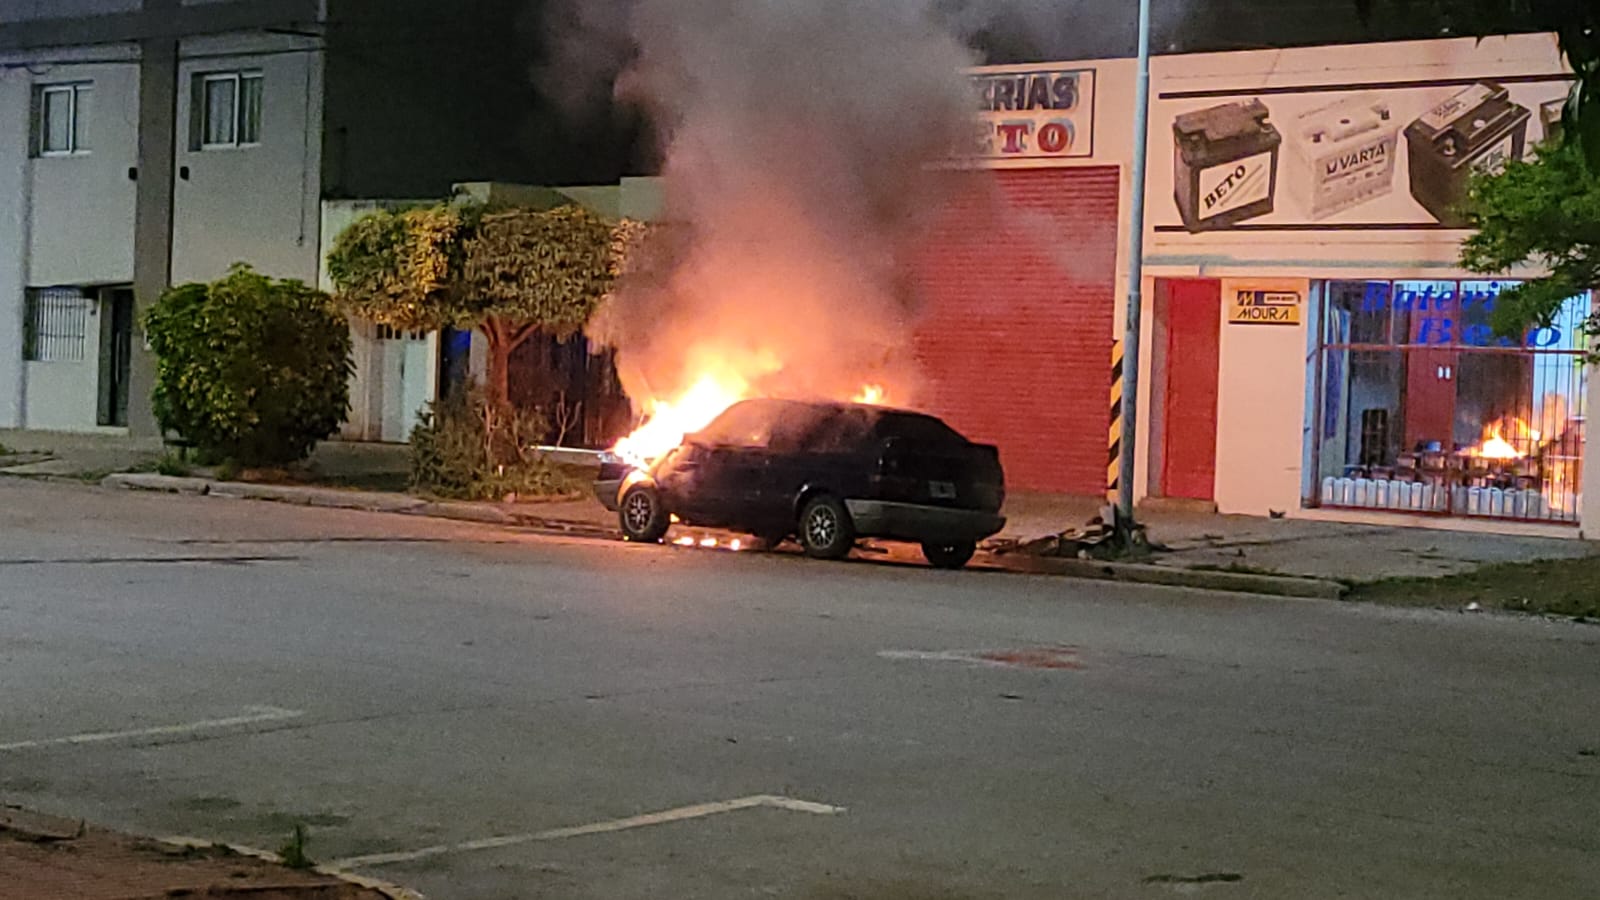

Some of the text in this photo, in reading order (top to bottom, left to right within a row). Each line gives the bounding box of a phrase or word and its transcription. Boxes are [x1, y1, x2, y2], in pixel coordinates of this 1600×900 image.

[976, 74, 1078, 111] ERIAS
[1340, 143, 1385, 170] VARTA
[1204, 165, 1246, 209] BETO
[1362, 281, 1499, 312] Bateri
[1237, 307, 1289, 320] MOURA
[1417, 317, 1561, 347] Beo
